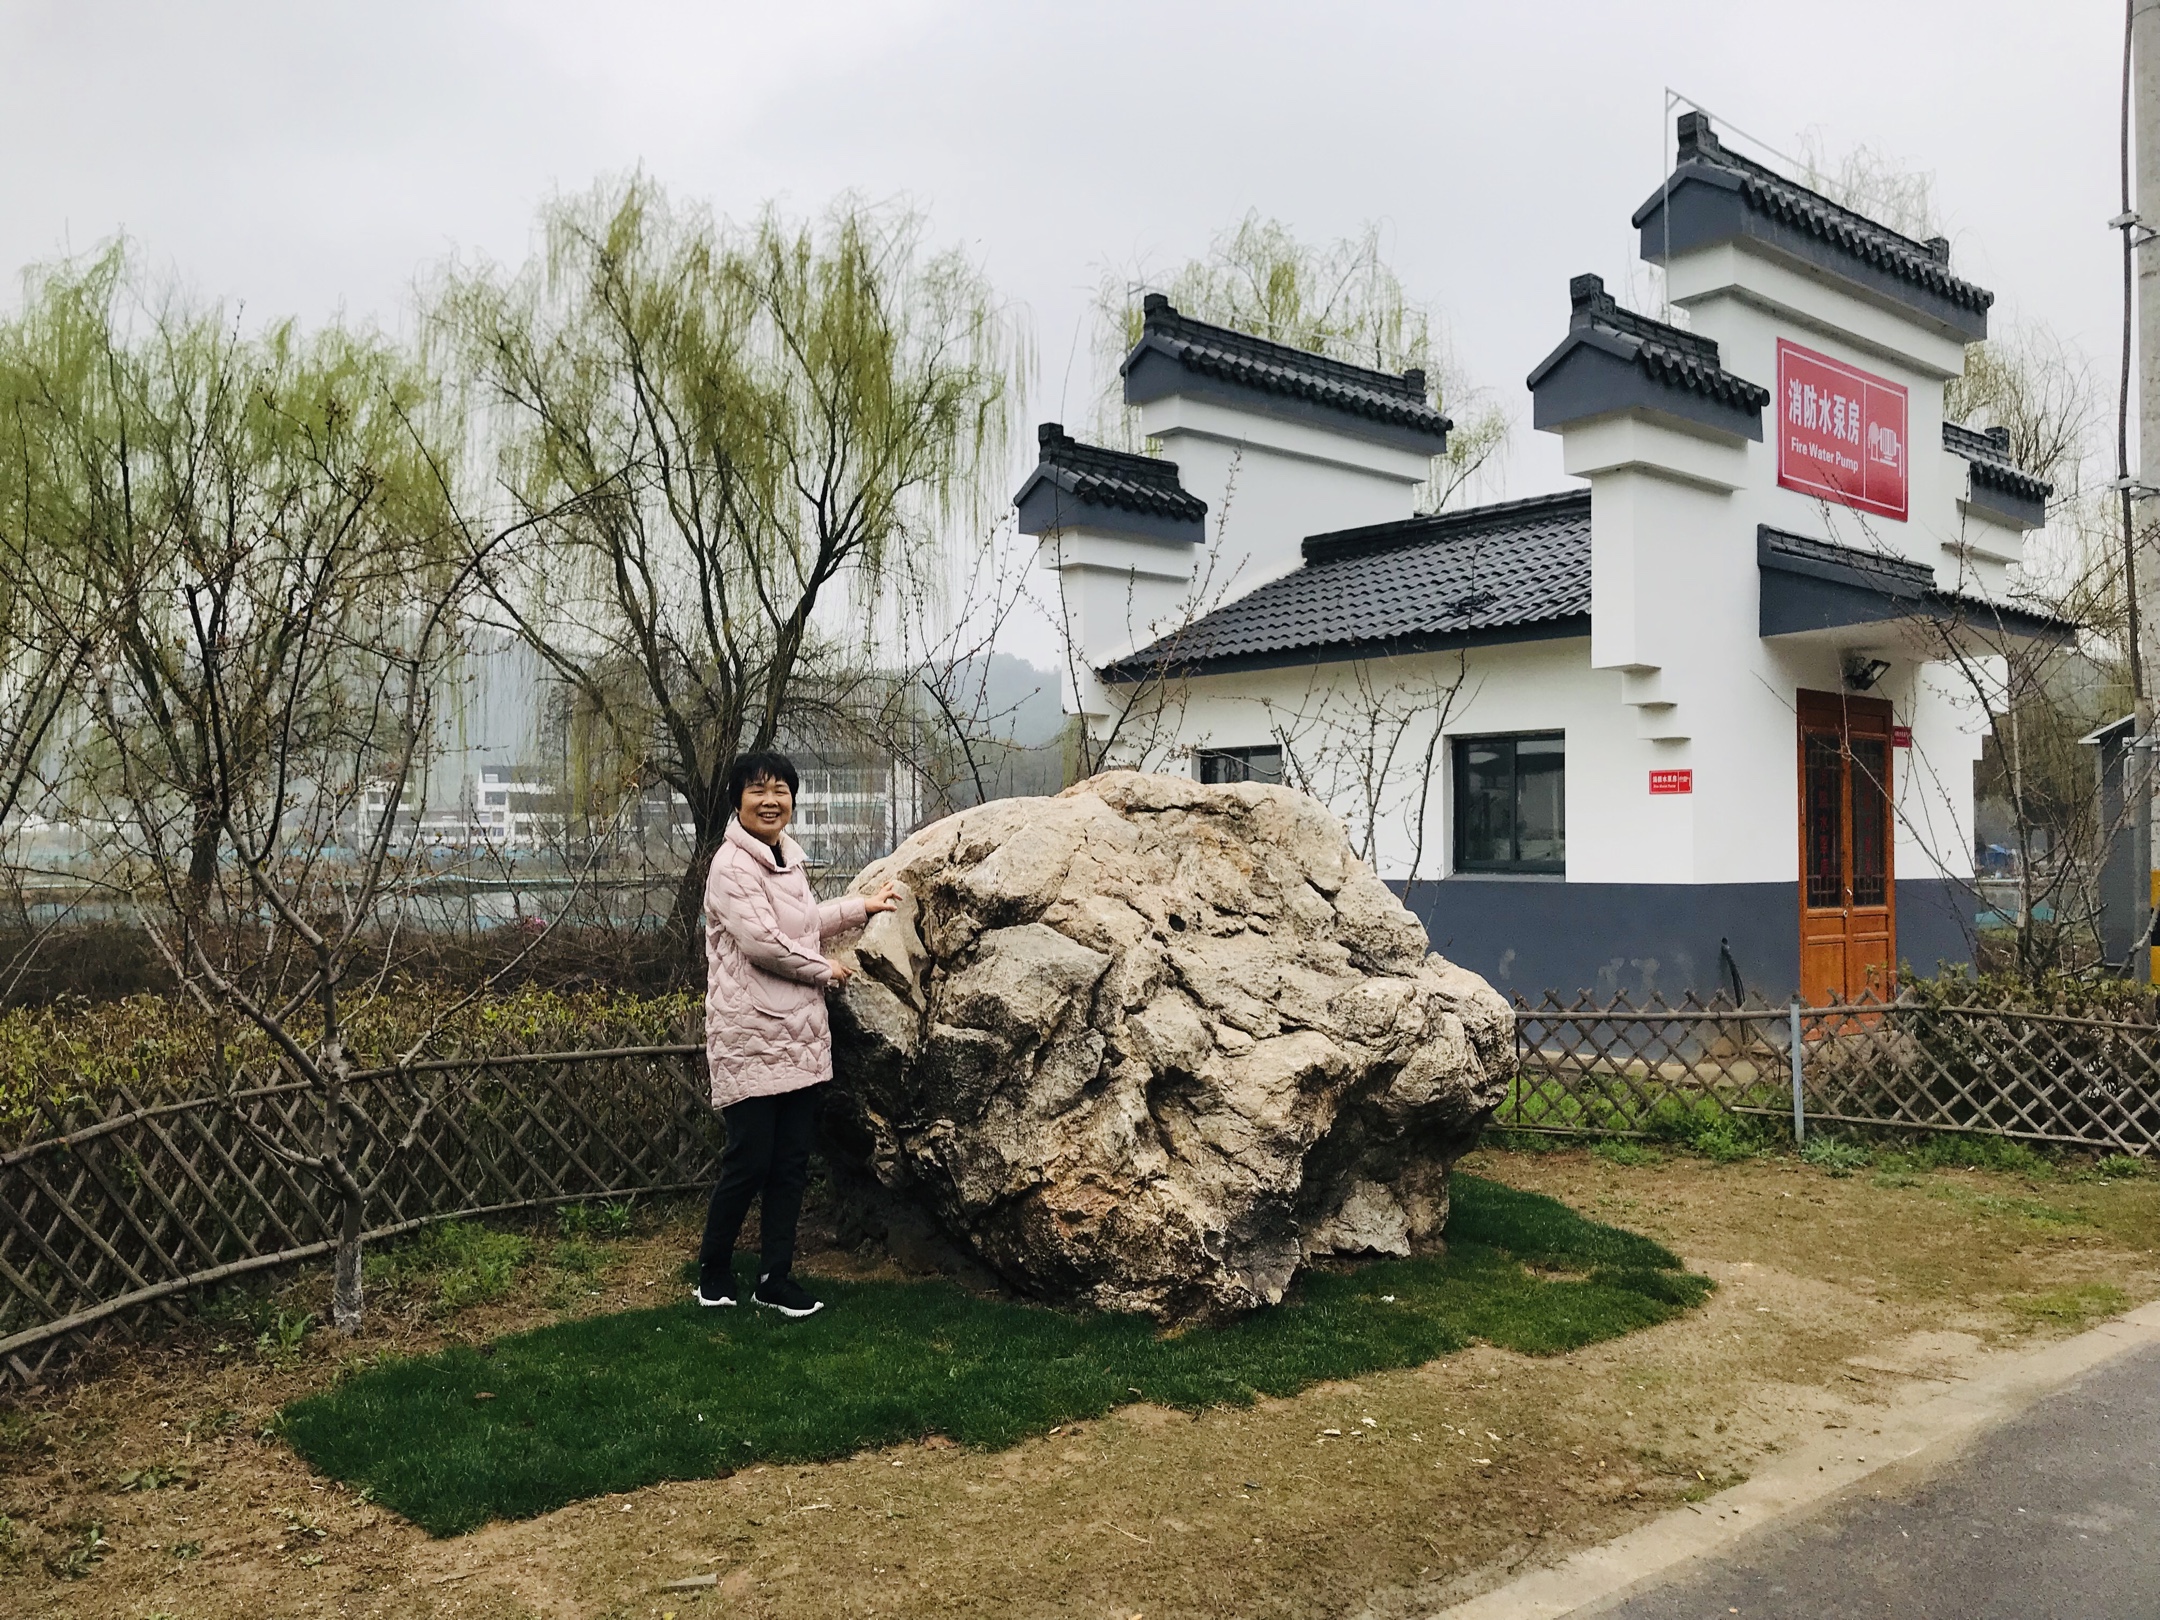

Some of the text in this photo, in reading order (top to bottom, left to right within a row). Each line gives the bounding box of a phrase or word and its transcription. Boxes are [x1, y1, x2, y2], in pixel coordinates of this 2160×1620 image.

[1788, 378, 1860, 446] 消防水泵房
[1791, 437, 1859, 474] Fire Water Pump
